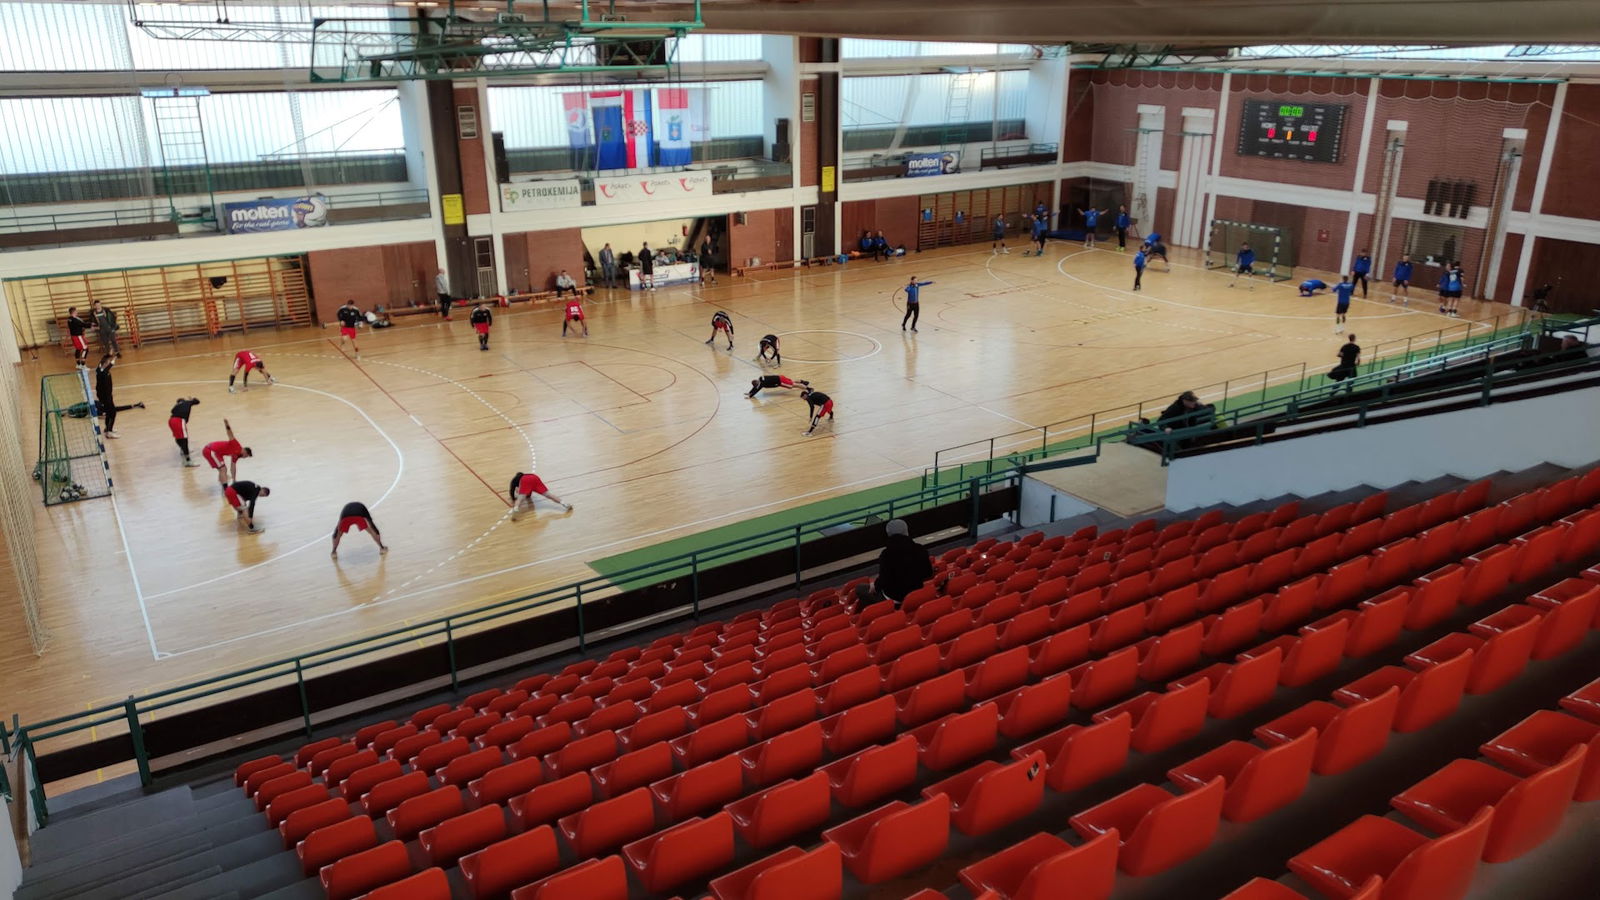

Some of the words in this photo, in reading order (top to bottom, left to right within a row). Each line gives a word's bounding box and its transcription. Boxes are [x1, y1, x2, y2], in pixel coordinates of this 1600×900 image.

[909, 158, 939, 169] molten
[522, 186, 579, 198] PETROKEMIJA
[231, 206, 289, 221] molten
